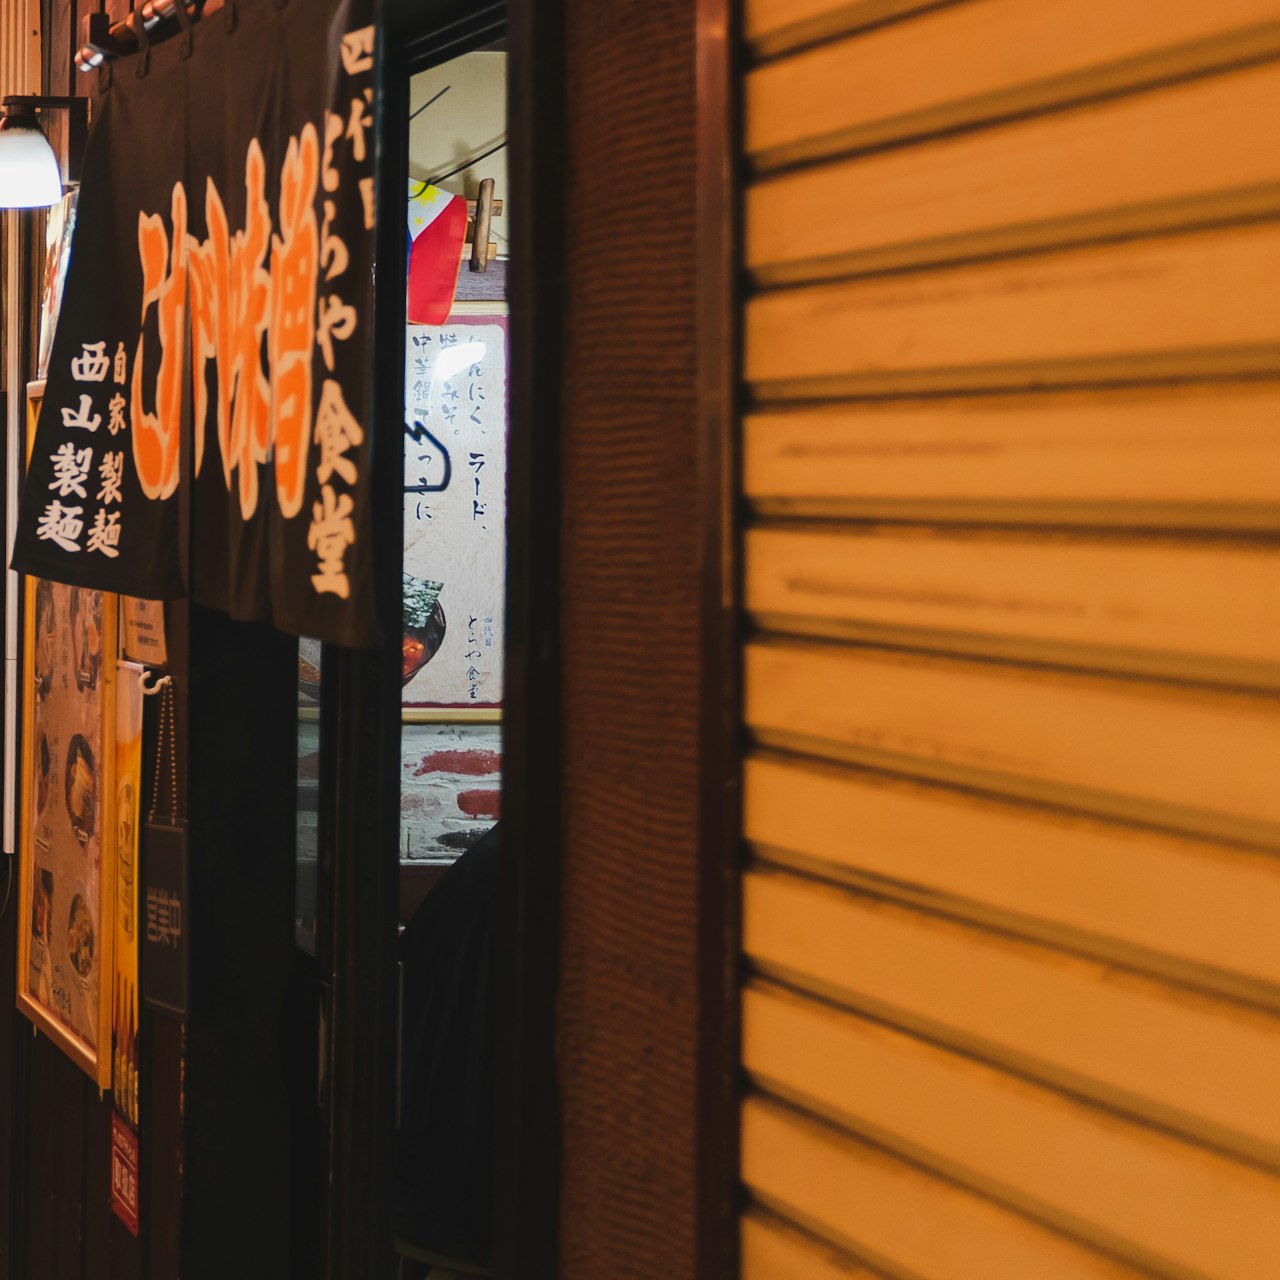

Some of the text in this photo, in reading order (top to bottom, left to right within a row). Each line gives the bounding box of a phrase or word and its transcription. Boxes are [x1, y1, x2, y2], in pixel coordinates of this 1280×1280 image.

[36, 340, 111, 553] 西山製麺
[86, 341, 127, 558] 自家製麺
